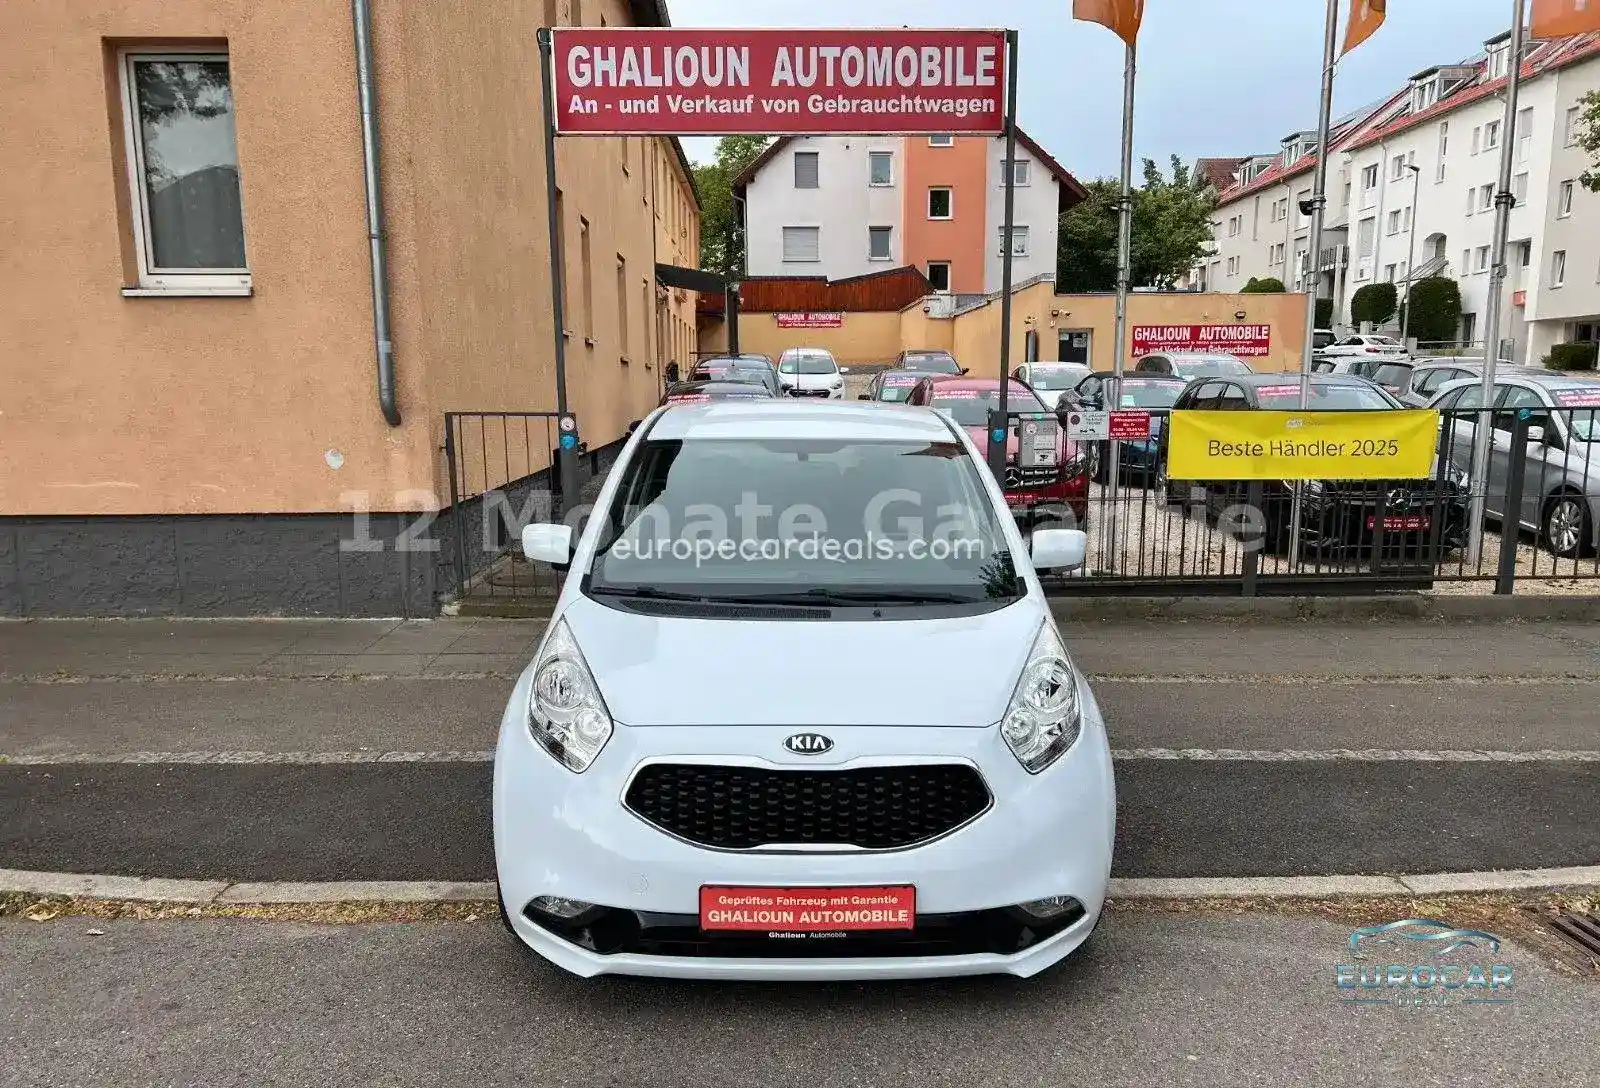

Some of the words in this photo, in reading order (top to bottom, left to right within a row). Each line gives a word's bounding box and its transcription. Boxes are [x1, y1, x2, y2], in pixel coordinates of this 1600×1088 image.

[567, 46, 749, 87] GHALIOUN
[771, 46, 995, 87] AUTOMOBILE
[569, 96, 598, 113] An
[619, 95, 659, 114] und
[667, 95, 754, 114] Verkauf
[761, 101, 800, 114] von
[807, 95, 995, 118] Gebrauchtwagen
[1134, 327, 1191, 341] GHALIOUN
[1199, 326, 1269, 340] AUTOMOBILE
[1208, 439, 1263, 457] Beste
[1270, 438, 1345, 457] Händler
[1351, 439, 1398, 457] 2025
[790, 736, 827, 750] KIA
[718, 895, 774, 906] Geprüftes
[776, 896, 828, 907] Fahrzeug
[830, 895, 848, 905] mit
[851, 895, 899, 905] Garantie
[708, 910, 794, 924] GHALIOUN
[799, 909, 908, 923] AUTOMOBILE
[768, 931, 806, 939] Ghalioun
[809, 931, 847, 939] Automobile
